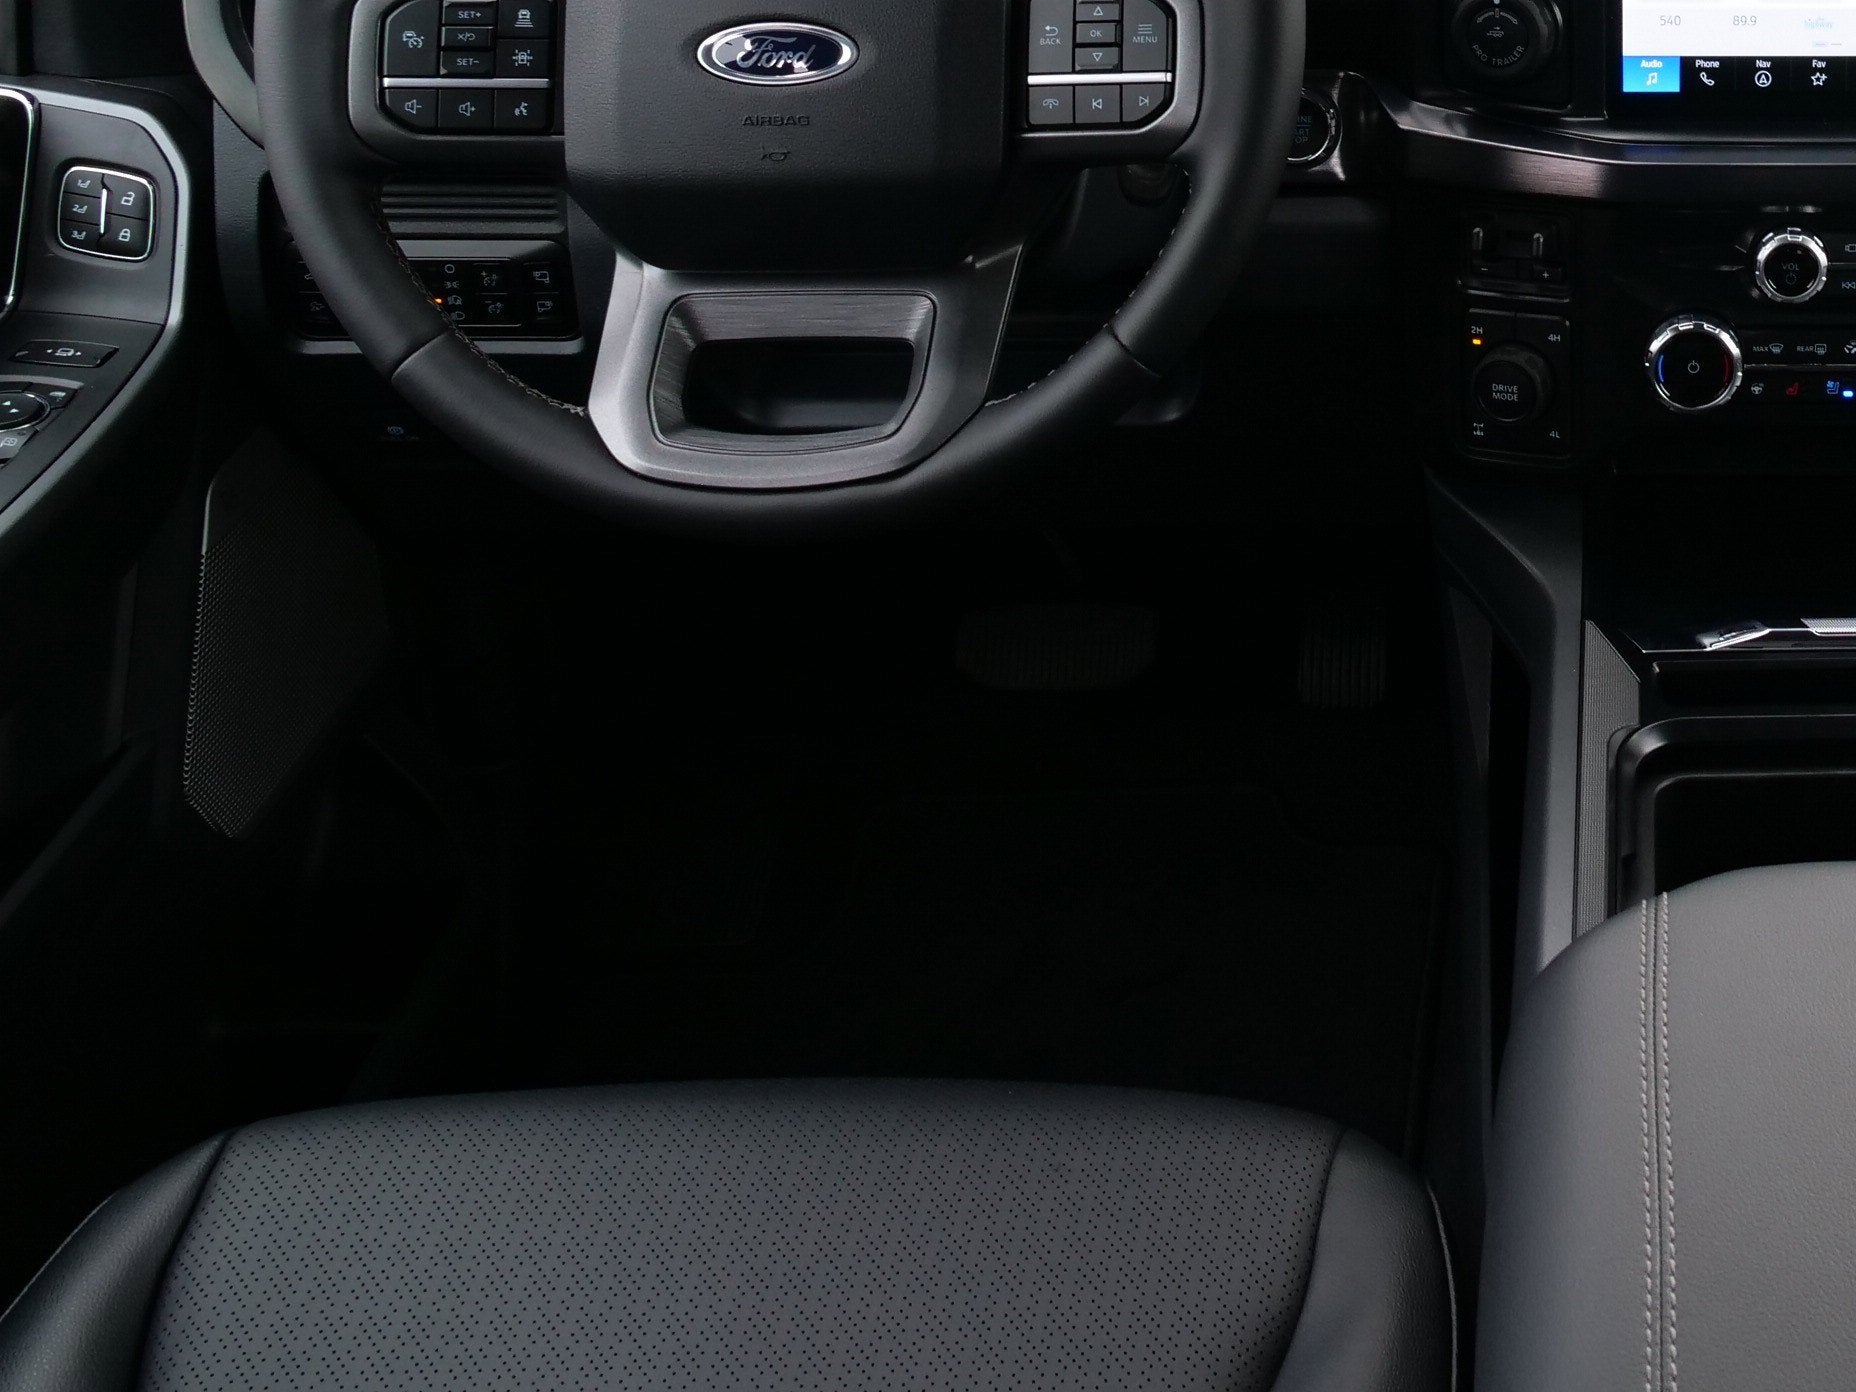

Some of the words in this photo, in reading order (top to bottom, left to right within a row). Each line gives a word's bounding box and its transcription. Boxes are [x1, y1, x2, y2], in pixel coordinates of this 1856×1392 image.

[1659, 15, 1682, 26] 540
[1732, 15, 1757, 26] 89.9
[1090, 29, 1103, 38] OK
[1039, 37, 1061, 46] BACK
[1132, 35, 1158, 44] MENU
[736, 35, 816, 69] Ford
[1640, 59, 1663, 68] Audio
[1695, 59, 1720, 68] Phone
[1756, 59, 1771, 68] Nav
[1812, 60, 1826, 68] Fav
[742, 115, 811, 127] AIRBAG
[1781, 262, 1800, 272] VOL
[1470, 326, 1483, 335] 2H
[1547, 334, 1561, 342] 4H
[1796, 345, 1815, 353] REAR
[1492, 383, 1519, 393] DRIVE
[1492, 392, 1519, 402] MODE
[1549, 430, 1561, 439] 4L
